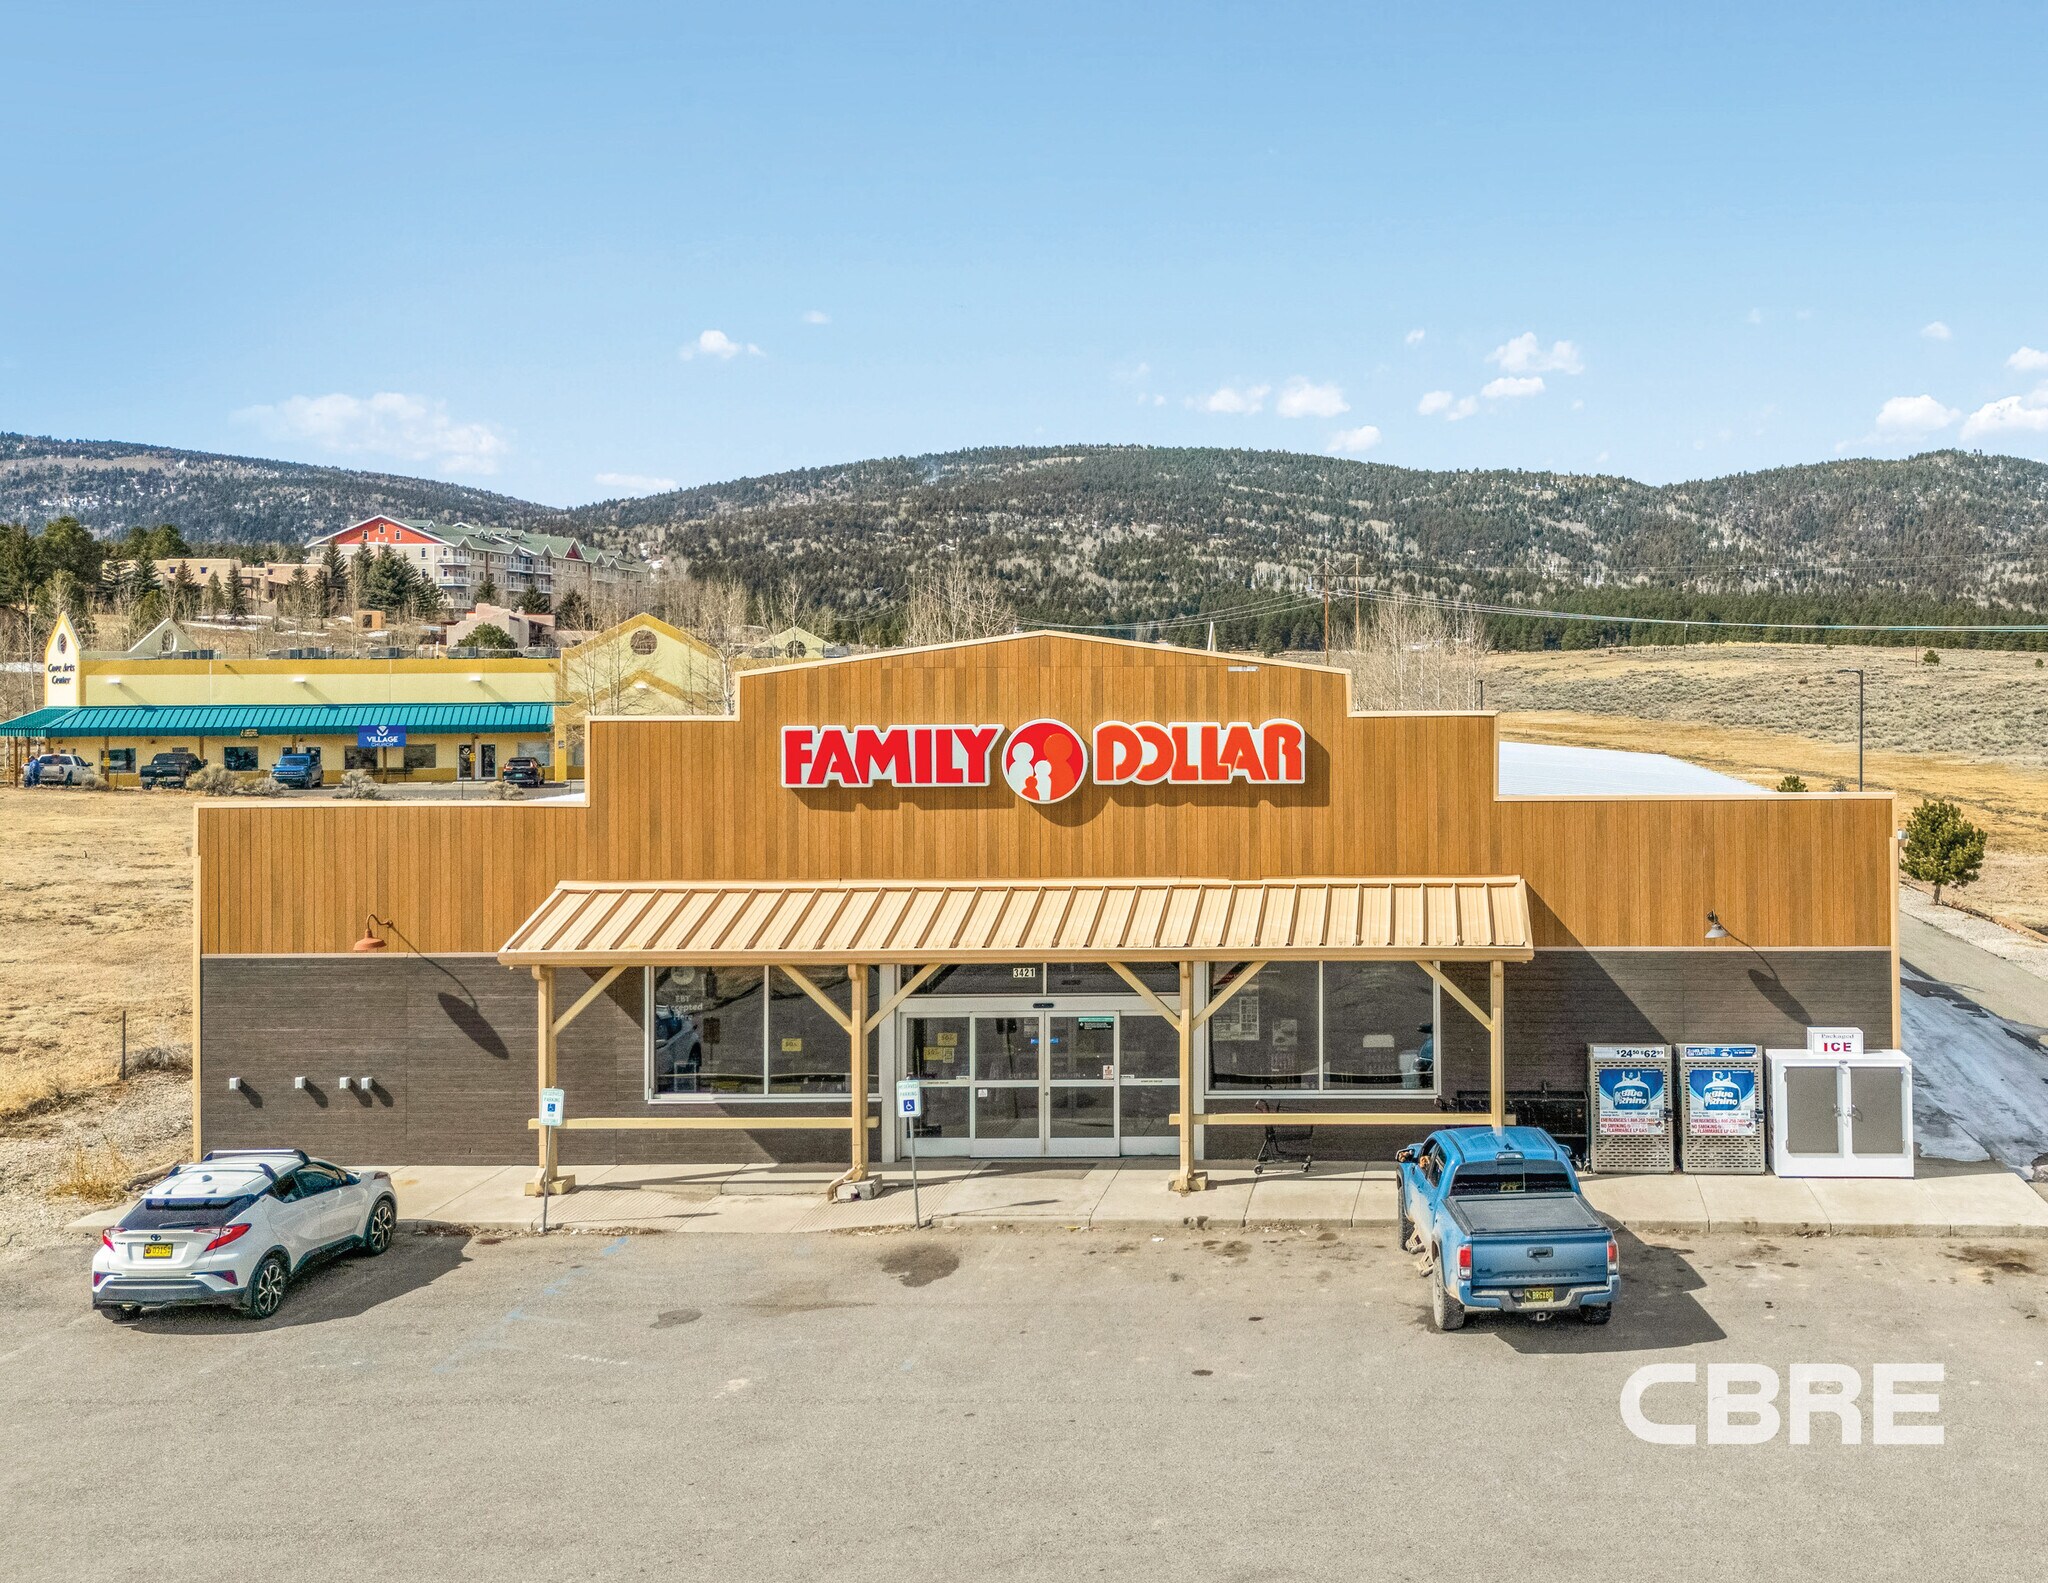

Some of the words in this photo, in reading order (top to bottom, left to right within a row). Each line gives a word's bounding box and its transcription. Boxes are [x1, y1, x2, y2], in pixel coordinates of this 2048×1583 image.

[52, 676, 71, 684] Center
[783, 727, 998, 785] FAMILY
[1096, 721, 1303, 782] DOLLAR
[1014, 968, 1034, 977] 3421
[1823, 1042, 1852, 1052] ICE
